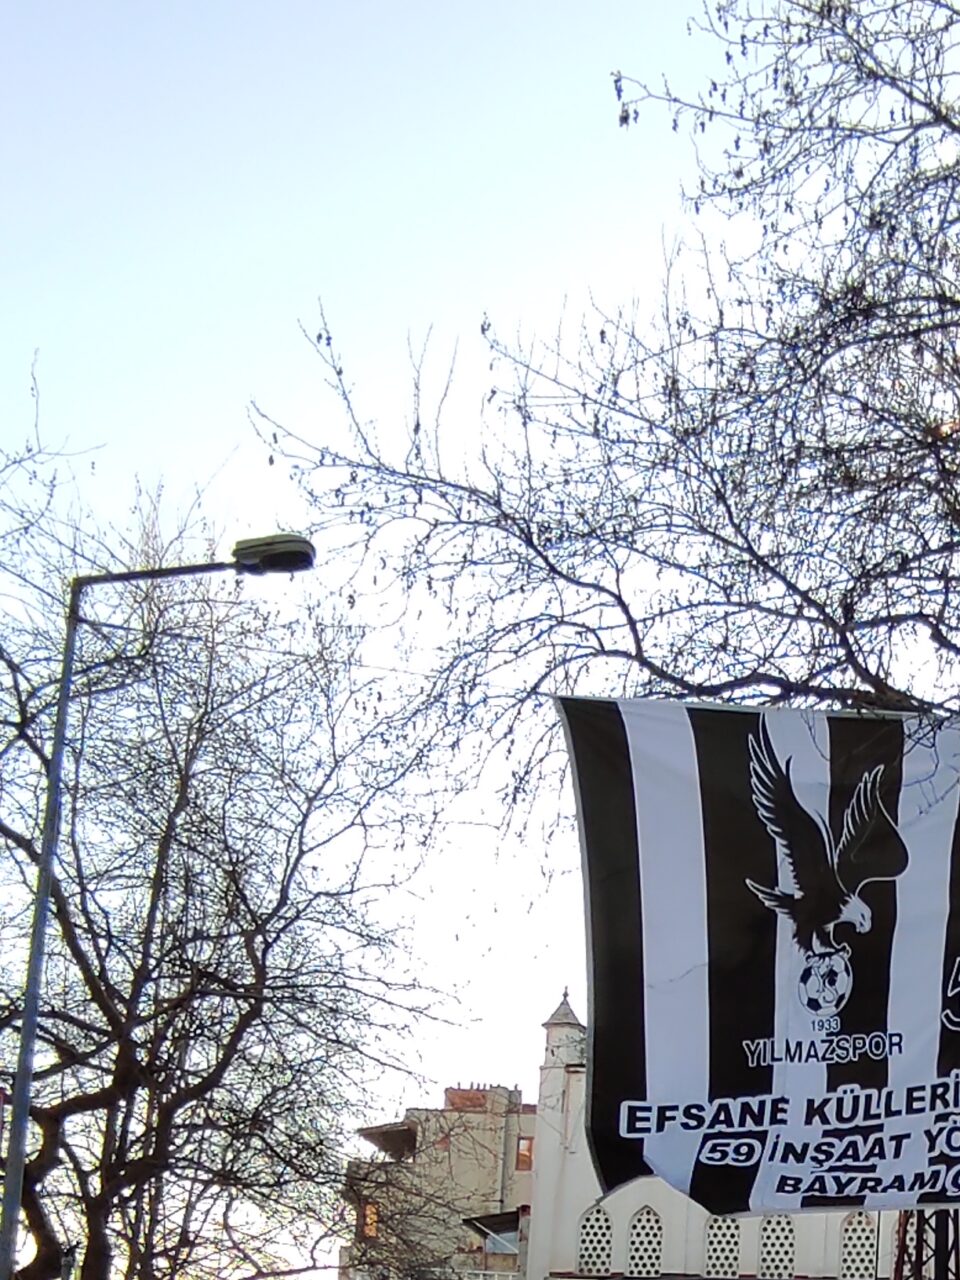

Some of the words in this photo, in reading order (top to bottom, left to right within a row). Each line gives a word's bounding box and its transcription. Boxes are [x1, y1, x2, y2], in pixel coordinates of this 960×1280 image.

[811, 1018, 840, 1032] 1933
[743, 1032, 903, 1067] YILMAZSPOR
[623, 1095, 790, 1135] EFSANE
[702, 1139, 760, 1164] 59
[767, 1132, 912, 1168] İNŞAAT
[775, 1169, 940, 1195] BAYRAM
